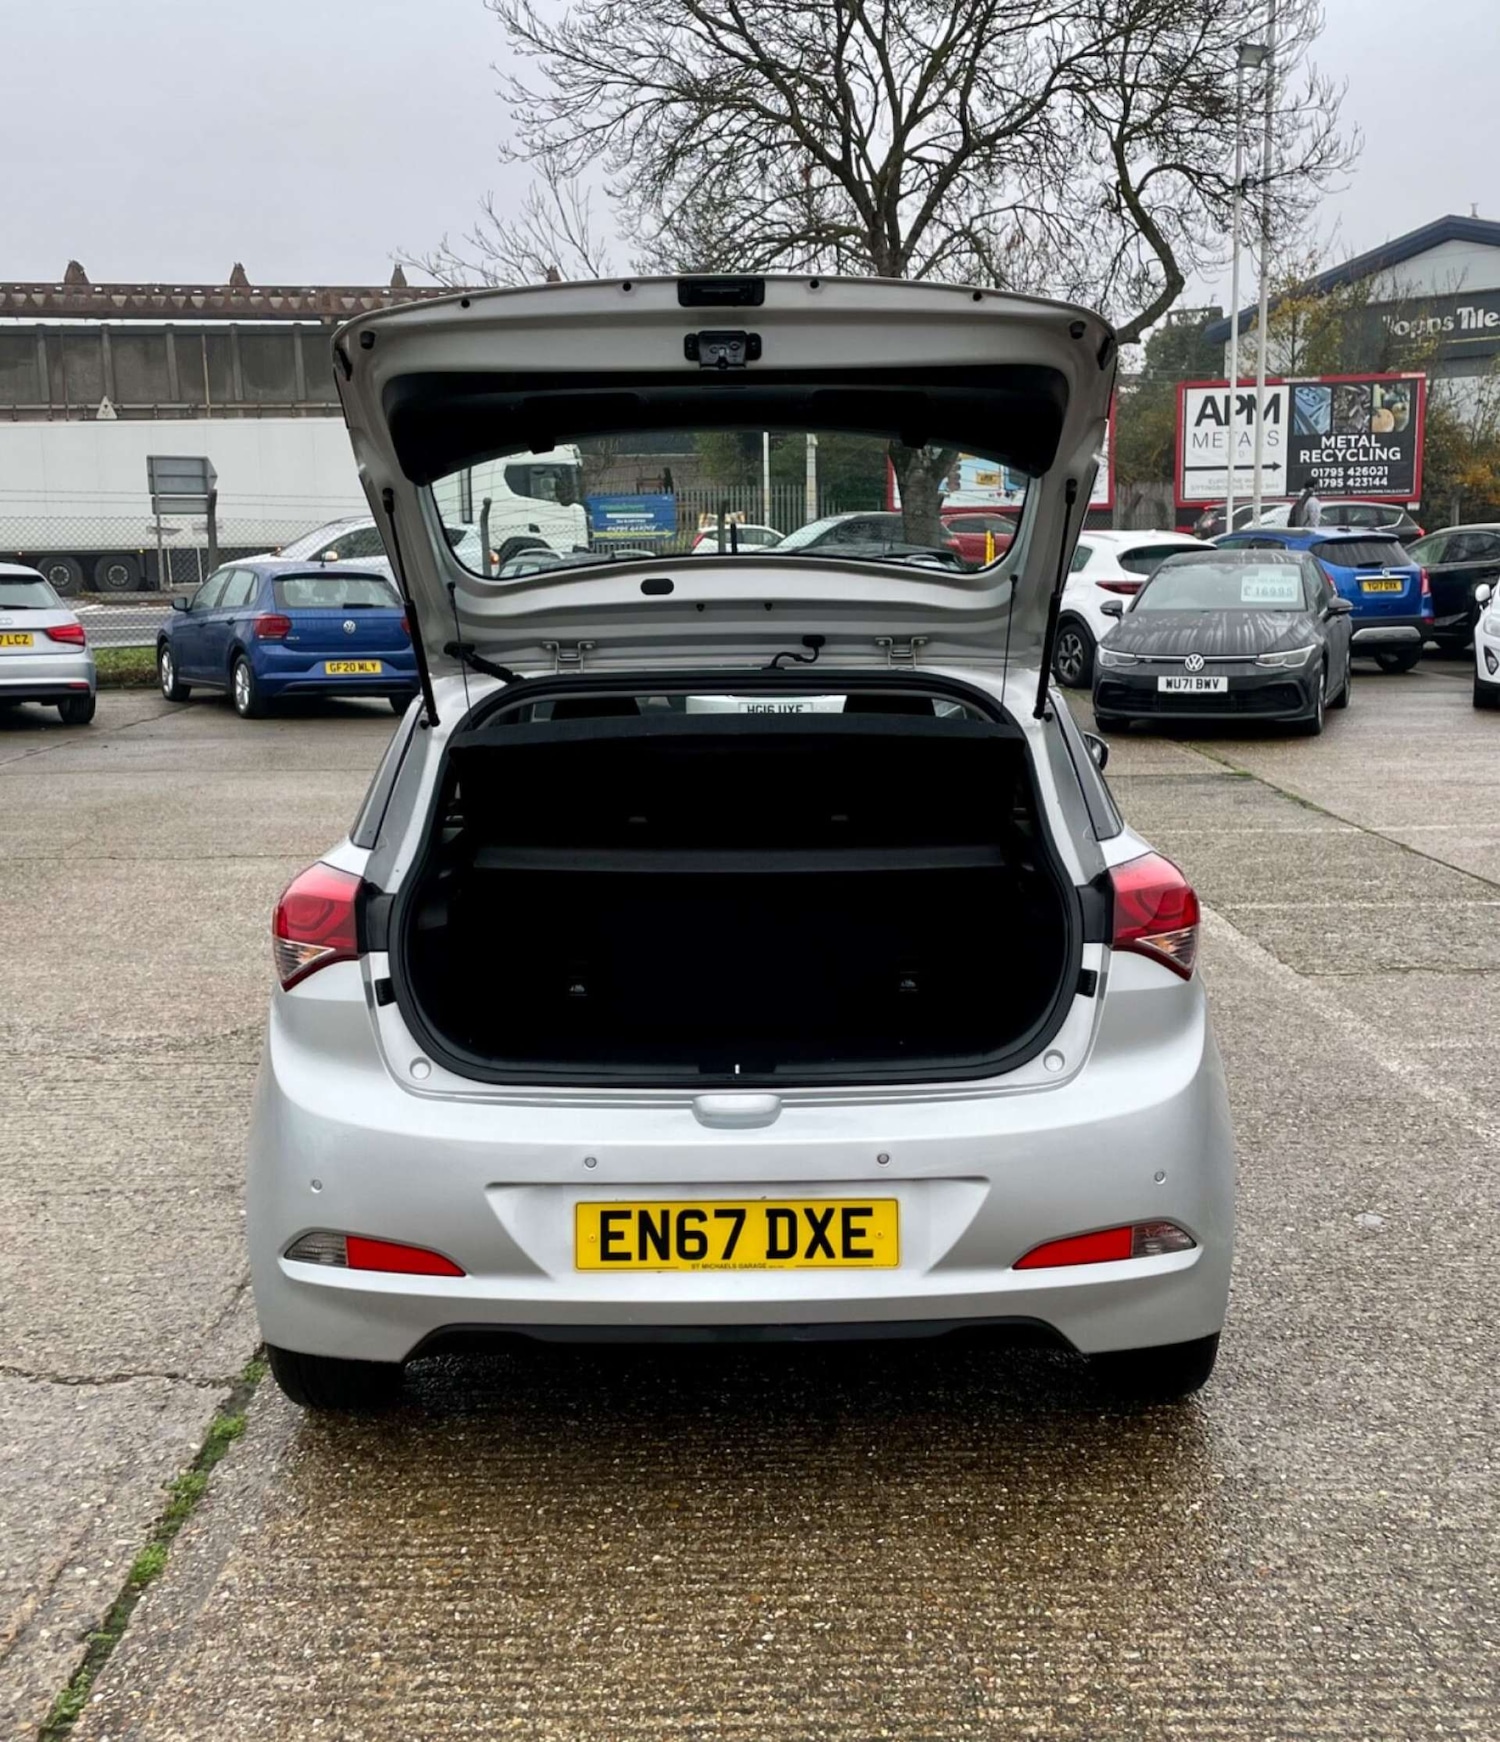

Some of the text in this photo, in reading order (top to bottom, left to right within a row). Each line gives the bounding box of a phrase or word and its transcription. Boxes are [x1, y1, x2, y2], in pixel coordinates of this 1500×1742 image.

[1456, 306, 1500, 329] Tile
[1194, 393, 1281, 427] APM
[1193, 430, 1279, 448] MEAS
[1321, 434, 1381, 449] METAL
[1300, 447, 1401, 463] RECYCLING
[1311, 466, 1389, 477] 01795 426021
[1319, 477, 1388, 488] 1795 423144
[6, 634, 29, 645] LCZ
[329, 662, 377, 672] GF20 WLY
[1165, 678, 1219, 690] WU71 BWV
[600, 1207, 874, 1261] EN67 DXE
